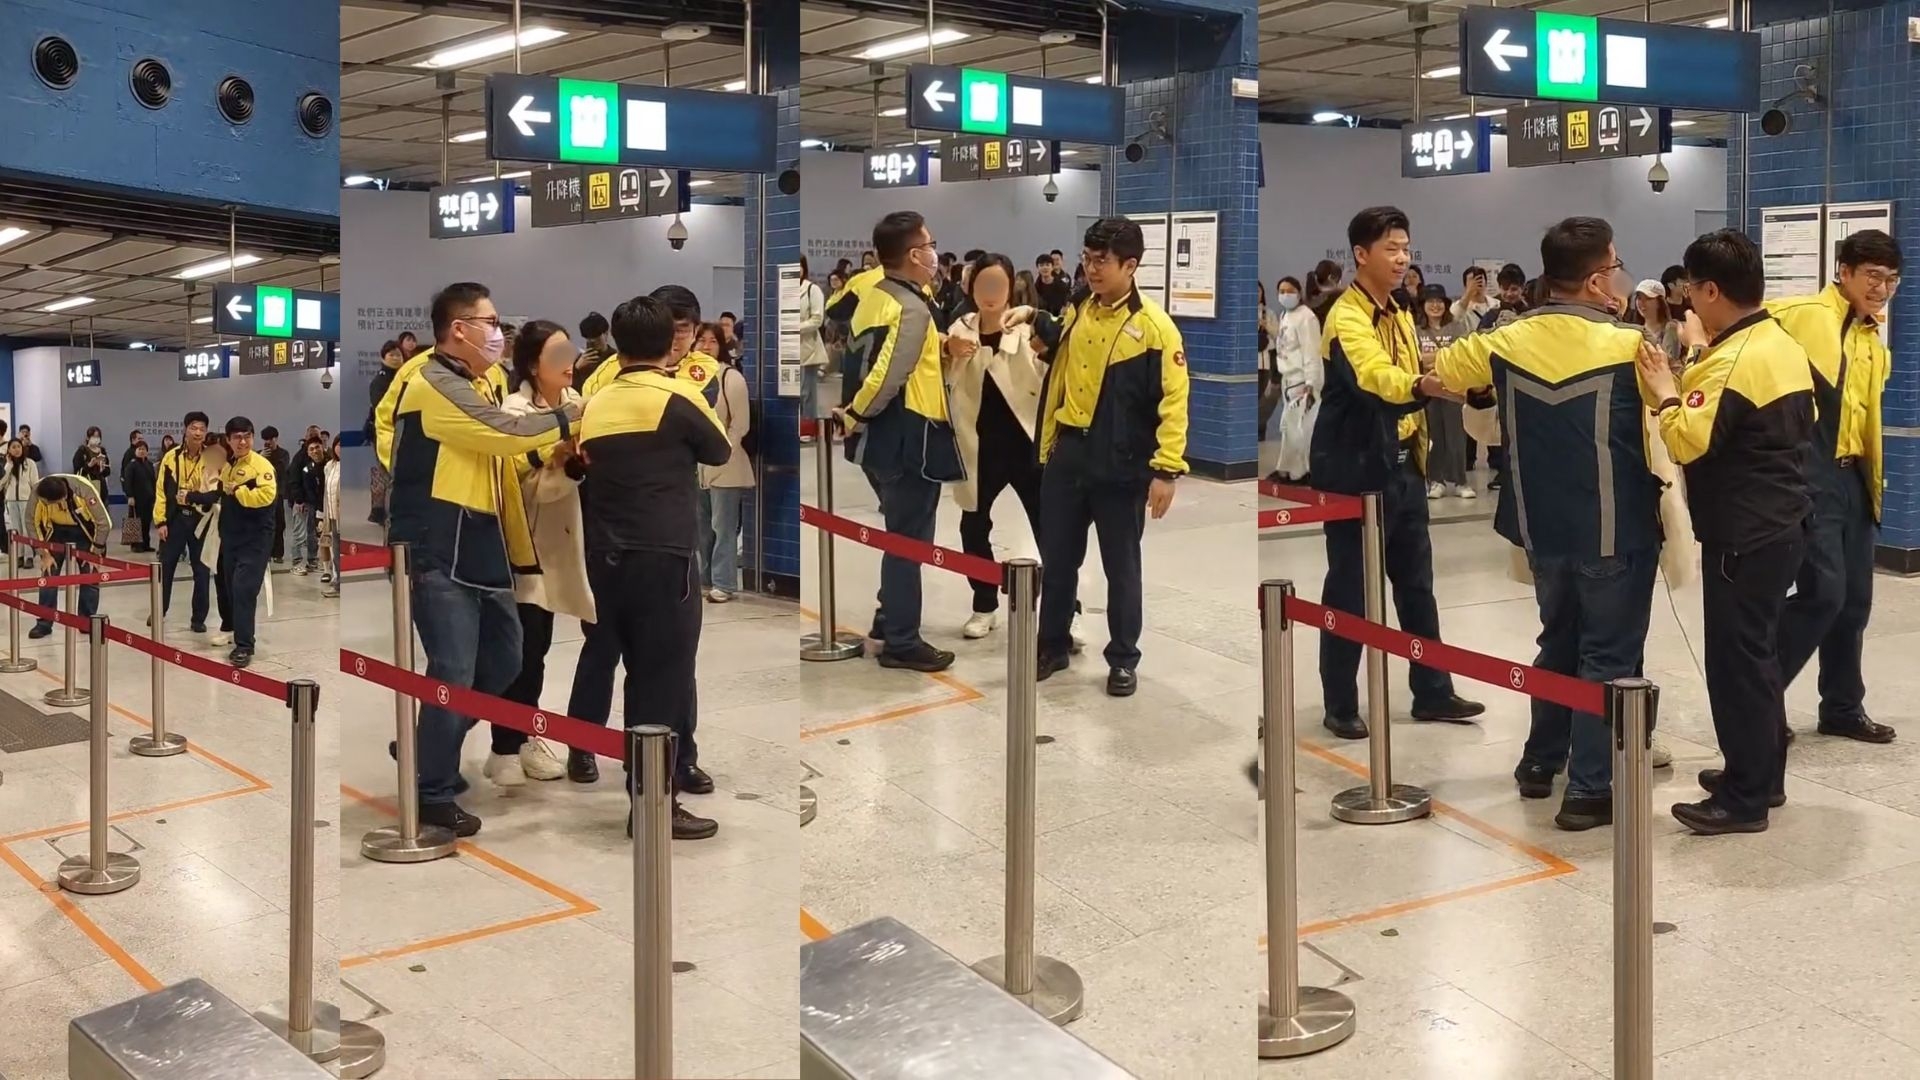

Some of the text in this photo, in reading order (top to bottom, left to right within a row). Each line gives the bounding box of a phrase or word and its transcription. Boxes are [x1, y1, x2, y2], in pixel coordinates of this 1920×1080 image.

[1522, 115, 1559, 139] 升降機
[1548, 142, 1559, 152] Lift
[546, 177, 581, 200] 升降機
[571, 203, 581, 213] Lift
